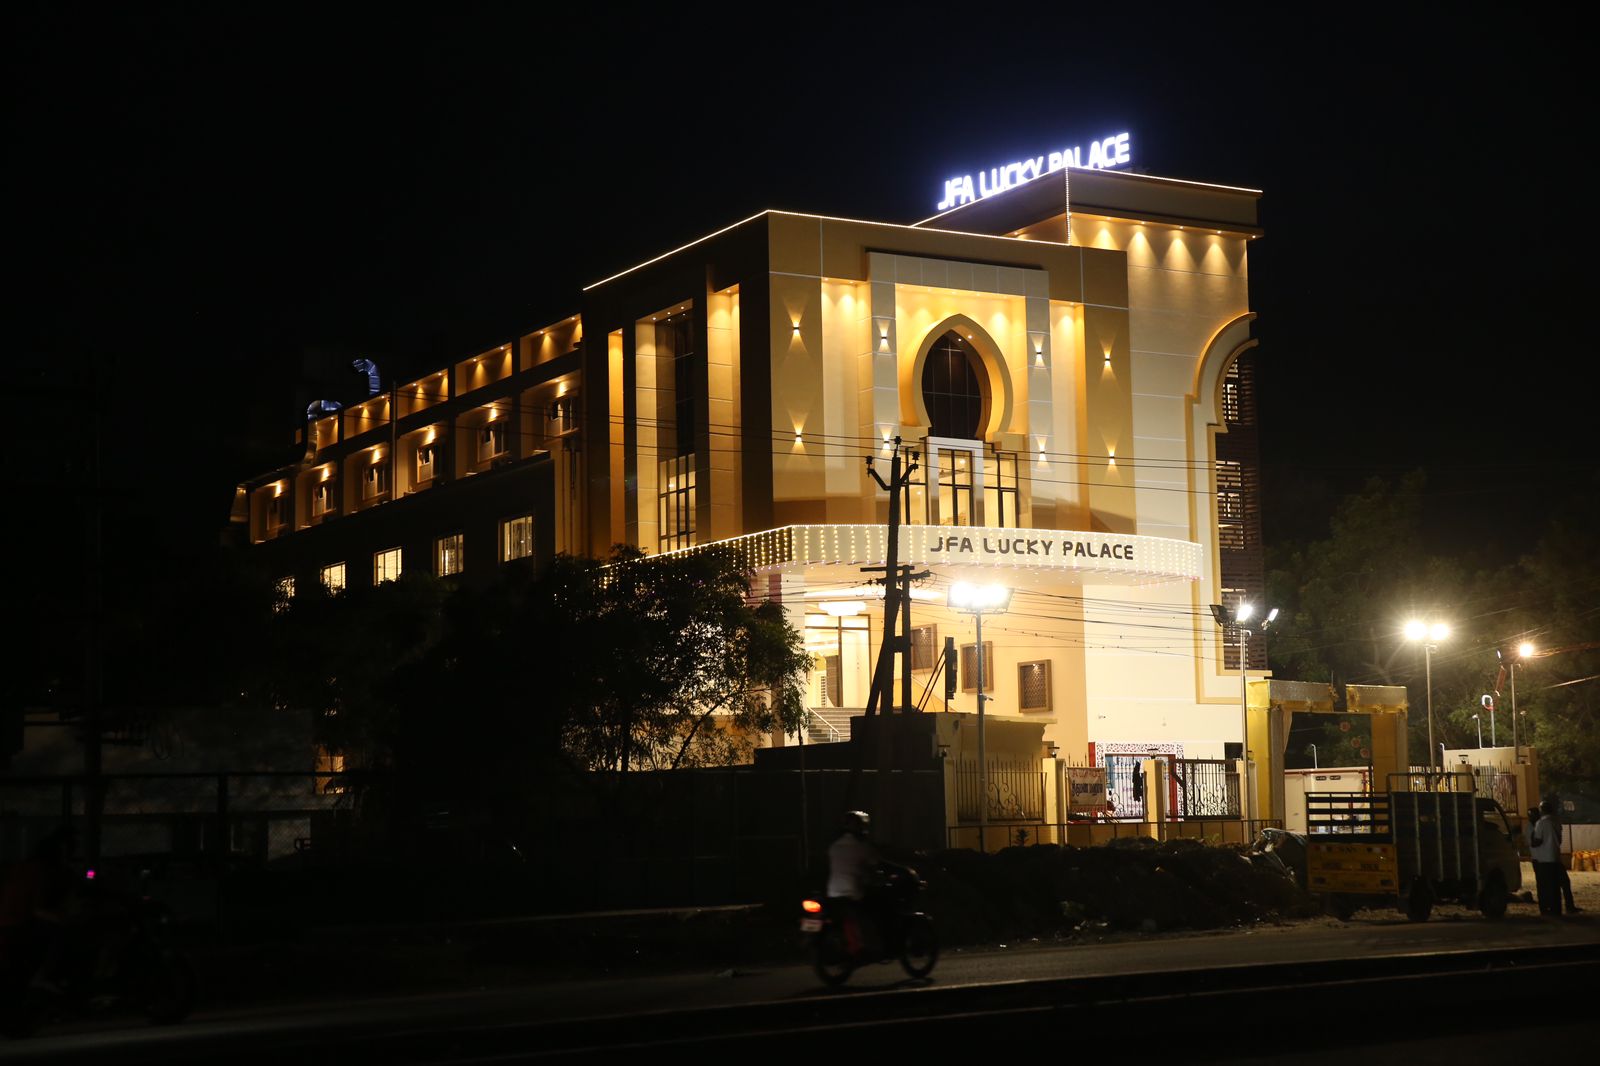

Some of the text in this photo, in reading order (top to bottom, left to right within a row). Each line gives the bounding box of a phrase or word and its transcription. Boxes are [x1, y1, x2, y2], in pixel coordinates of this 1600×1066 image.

[938, 132, 1130, 210] JFA LUCKY PALACE
[930, 536, 1134, 560] JFA LUCKY PALACE
